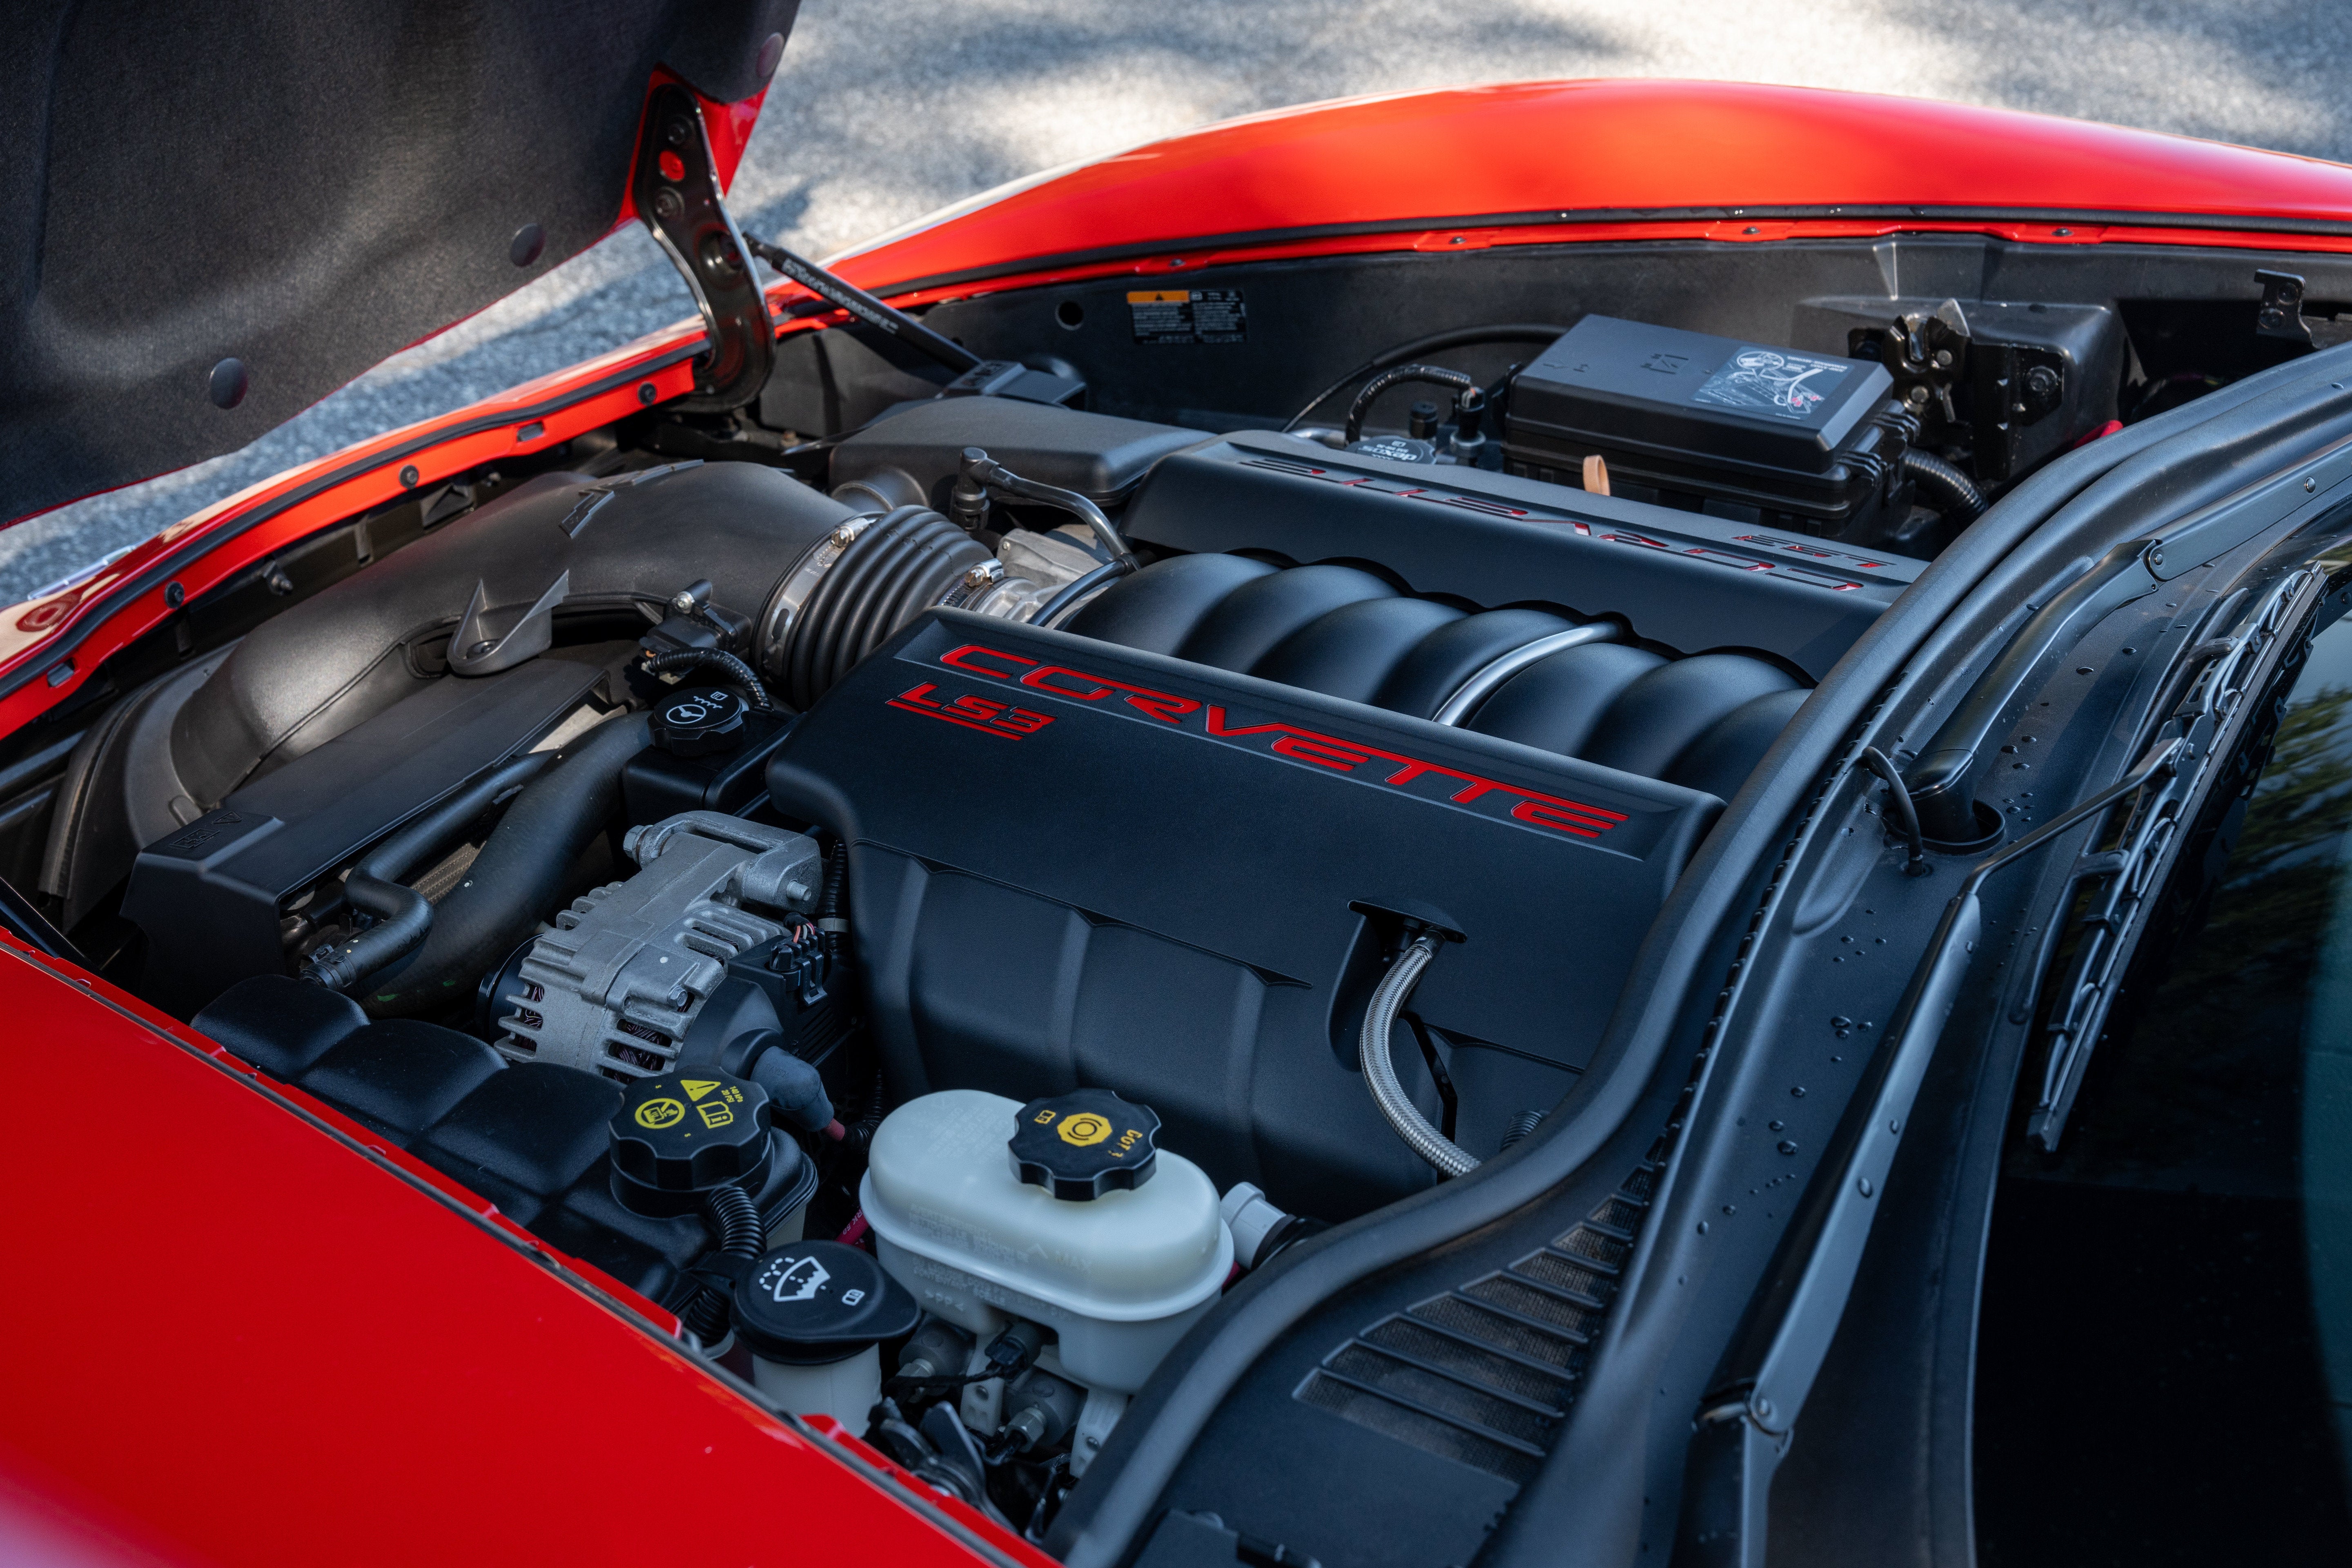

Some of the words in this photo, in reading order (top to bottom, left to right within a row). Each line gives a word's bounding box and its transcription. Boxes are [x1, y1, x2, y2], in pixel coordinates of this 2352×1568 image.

[1362, 445, 1417, 460] dexos
[1238, 459, 1864, 591] CORVETTE
[898, 681, 1058, 733] LS3
[940, 644, 1630, 838] CORVETTE
[1054, 1250, 1093, 1274] MAX
